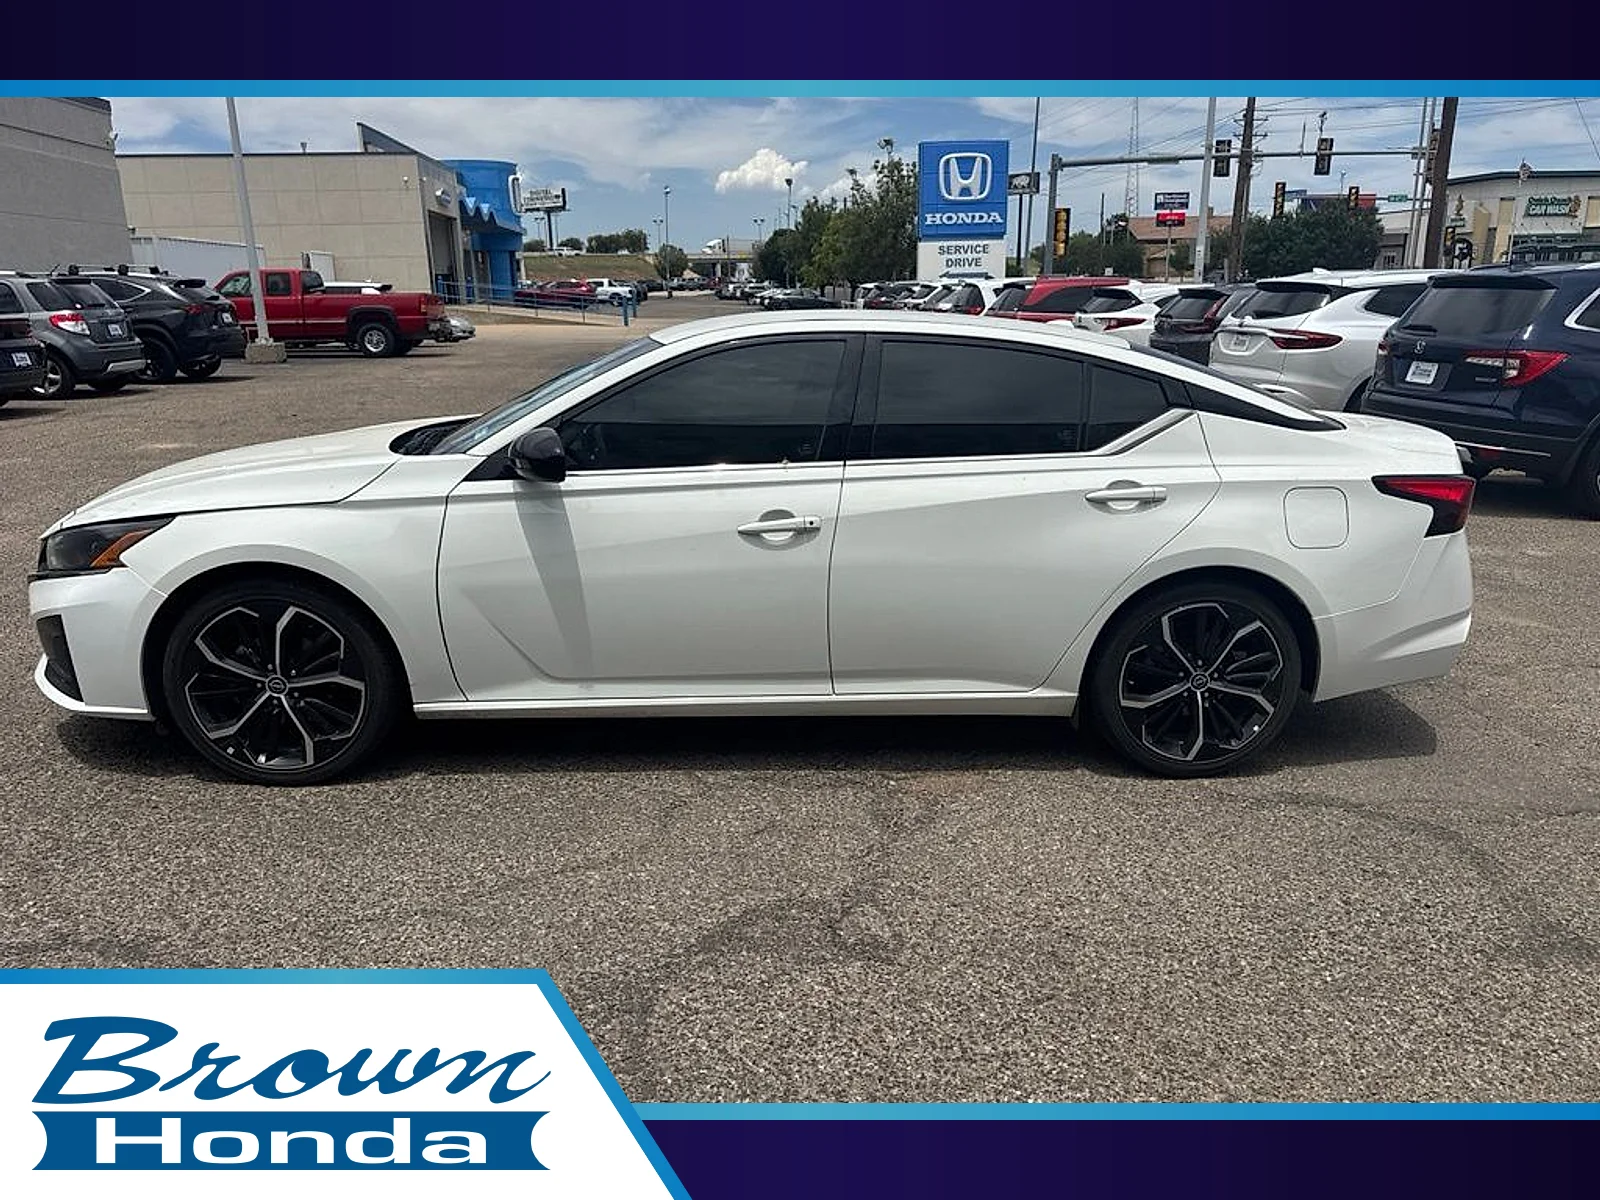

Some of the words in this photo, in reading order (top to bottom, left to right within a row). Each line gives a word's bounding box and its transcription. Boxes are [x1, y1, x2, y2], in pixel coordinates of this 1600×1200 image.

[925, 212, 1004, 225] HONDA
[938, 244, 989, 255] SERVICE
[945, 257, 982, 268] DRIVE
